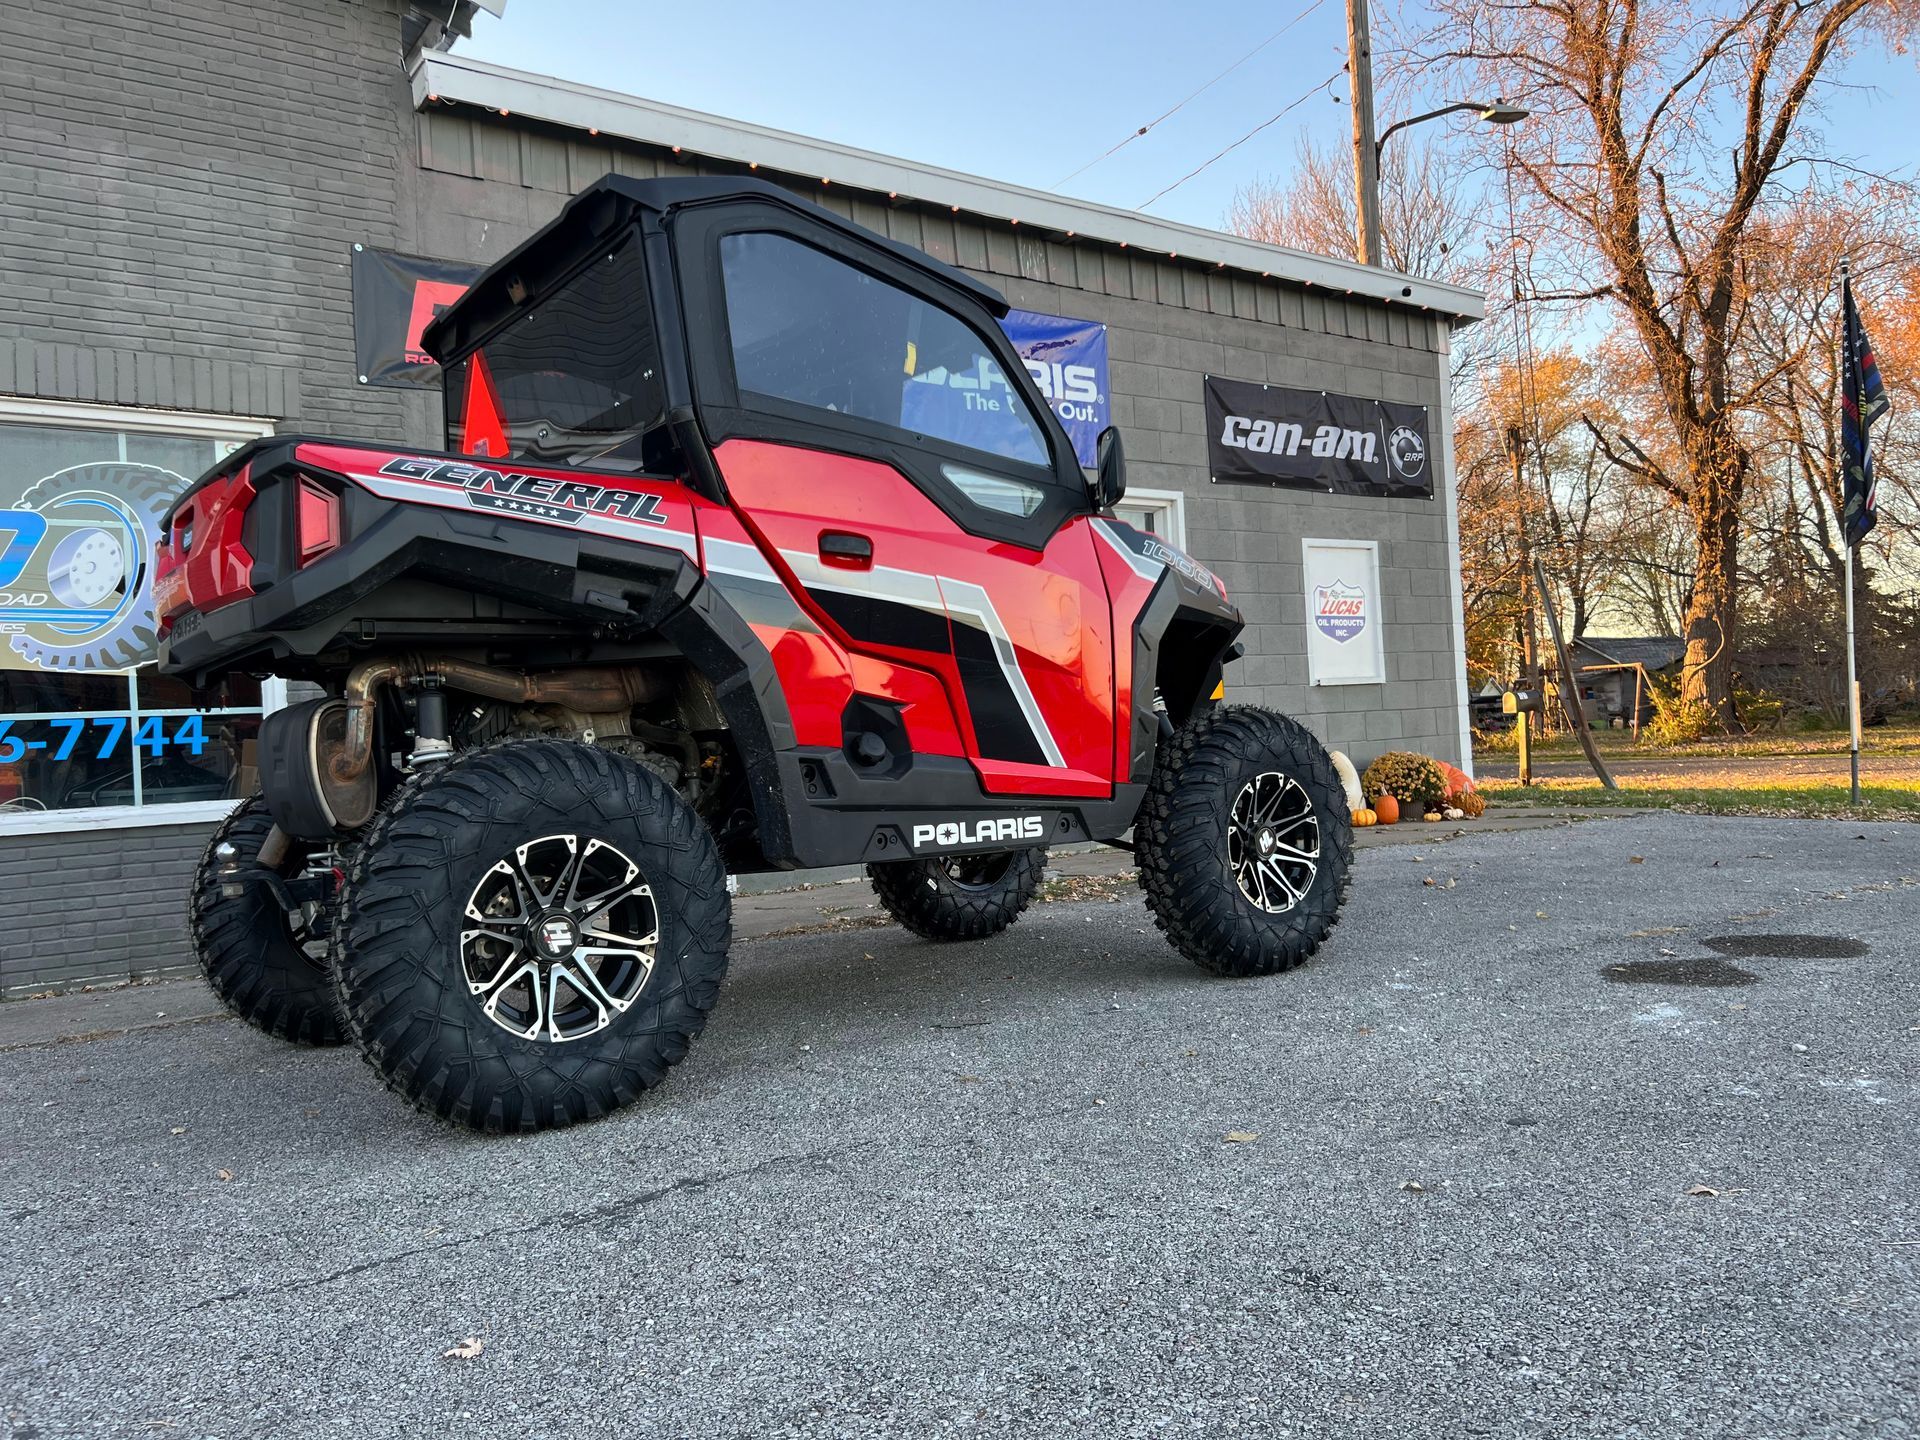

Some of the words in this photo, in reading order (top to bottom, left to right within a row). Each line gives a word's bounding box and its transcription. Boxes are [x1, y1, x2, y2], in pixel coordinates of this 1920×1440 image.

[963, 392, 1000, 412] The
[1058, 402, 1099, 423] Out.
[1221, 415, 1376, 463] can-am
[1403, 452, 1424, 462] BRP
[378, 457, 669, 525] GENERAL
[1142, 539, 1212, 590] 1000
[1317, 618, 1329, 626] OIL
[1330, 618, 1364, 627] PRODUCTS
[1320, 599, 1363, 615] LUCAS
[1335, 629, 1349, 637] INC.
[913, 815, 1044, 848] POLARIS
